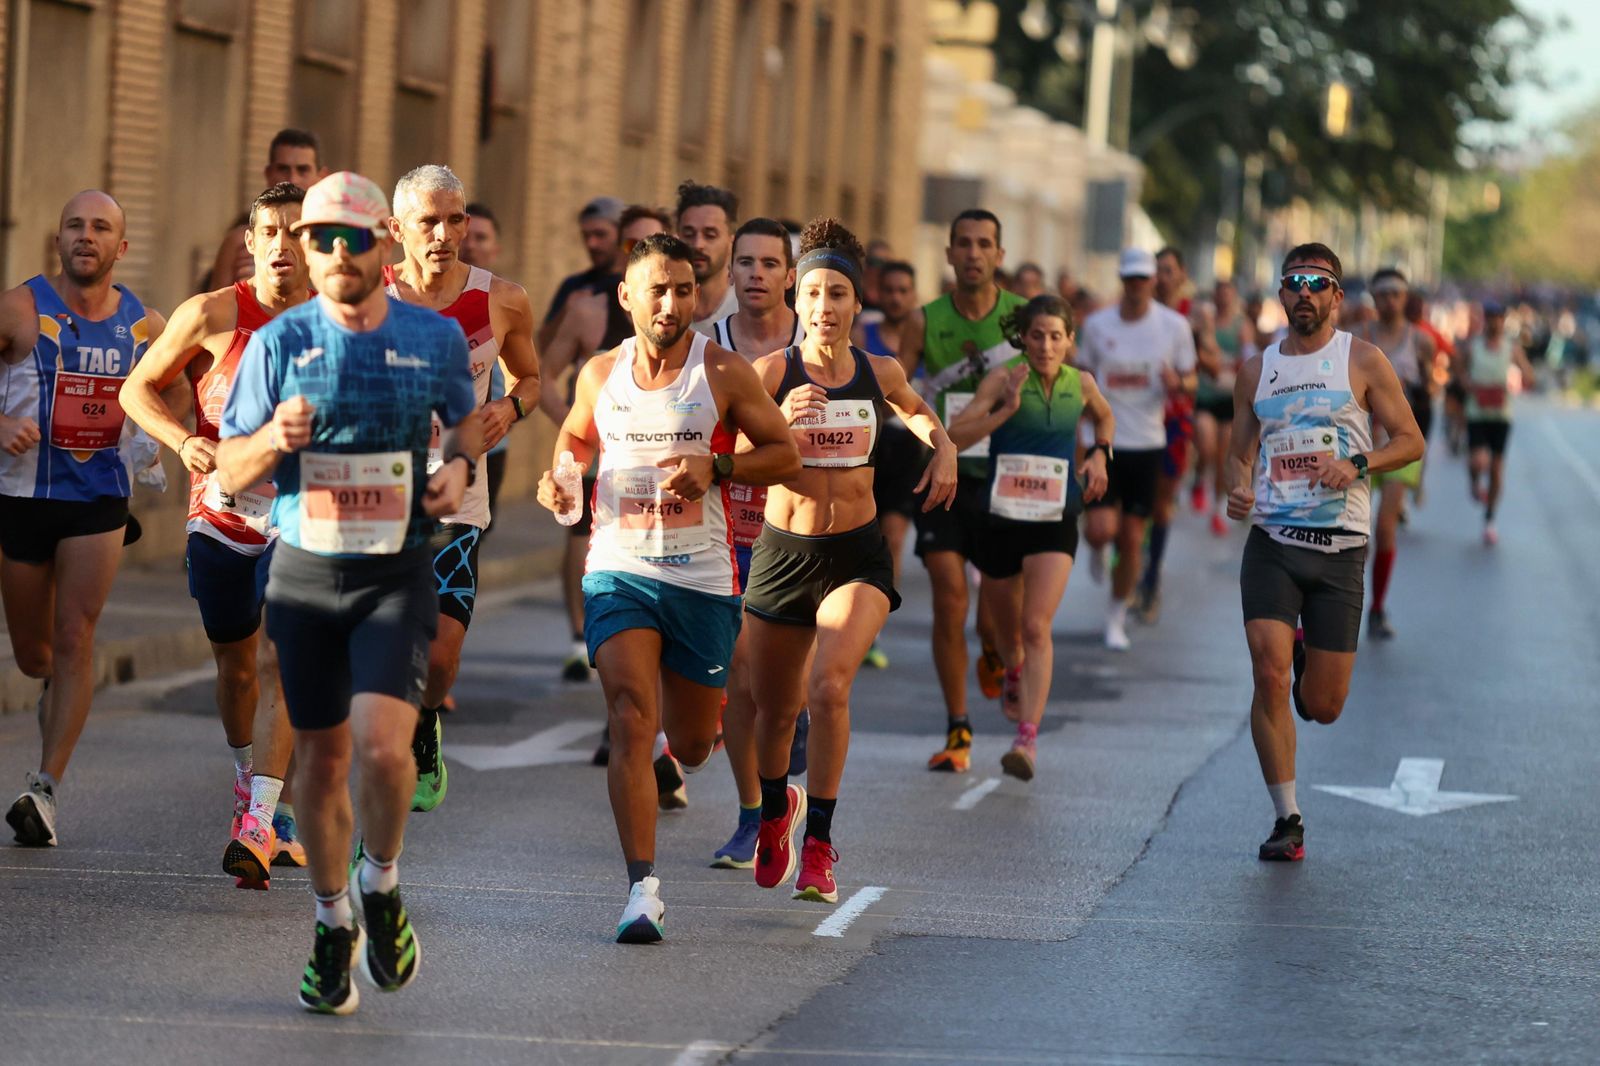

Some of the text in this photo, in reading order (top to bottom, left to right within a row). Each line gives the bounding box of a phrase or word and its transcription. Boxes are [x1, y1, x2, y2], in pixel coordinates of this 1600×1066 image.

[77, 346, 121, 374] TAC
[1271, 382, 1327, 397] ARGENTINA
[82, 403, 106, 415] 624
[808, 431, 854, 446] 10422
[1014, 477, 1047, 491] 14324
[331, 490, 381, 505] 10171
[1278, 525, 1333, 546] 226ERS
